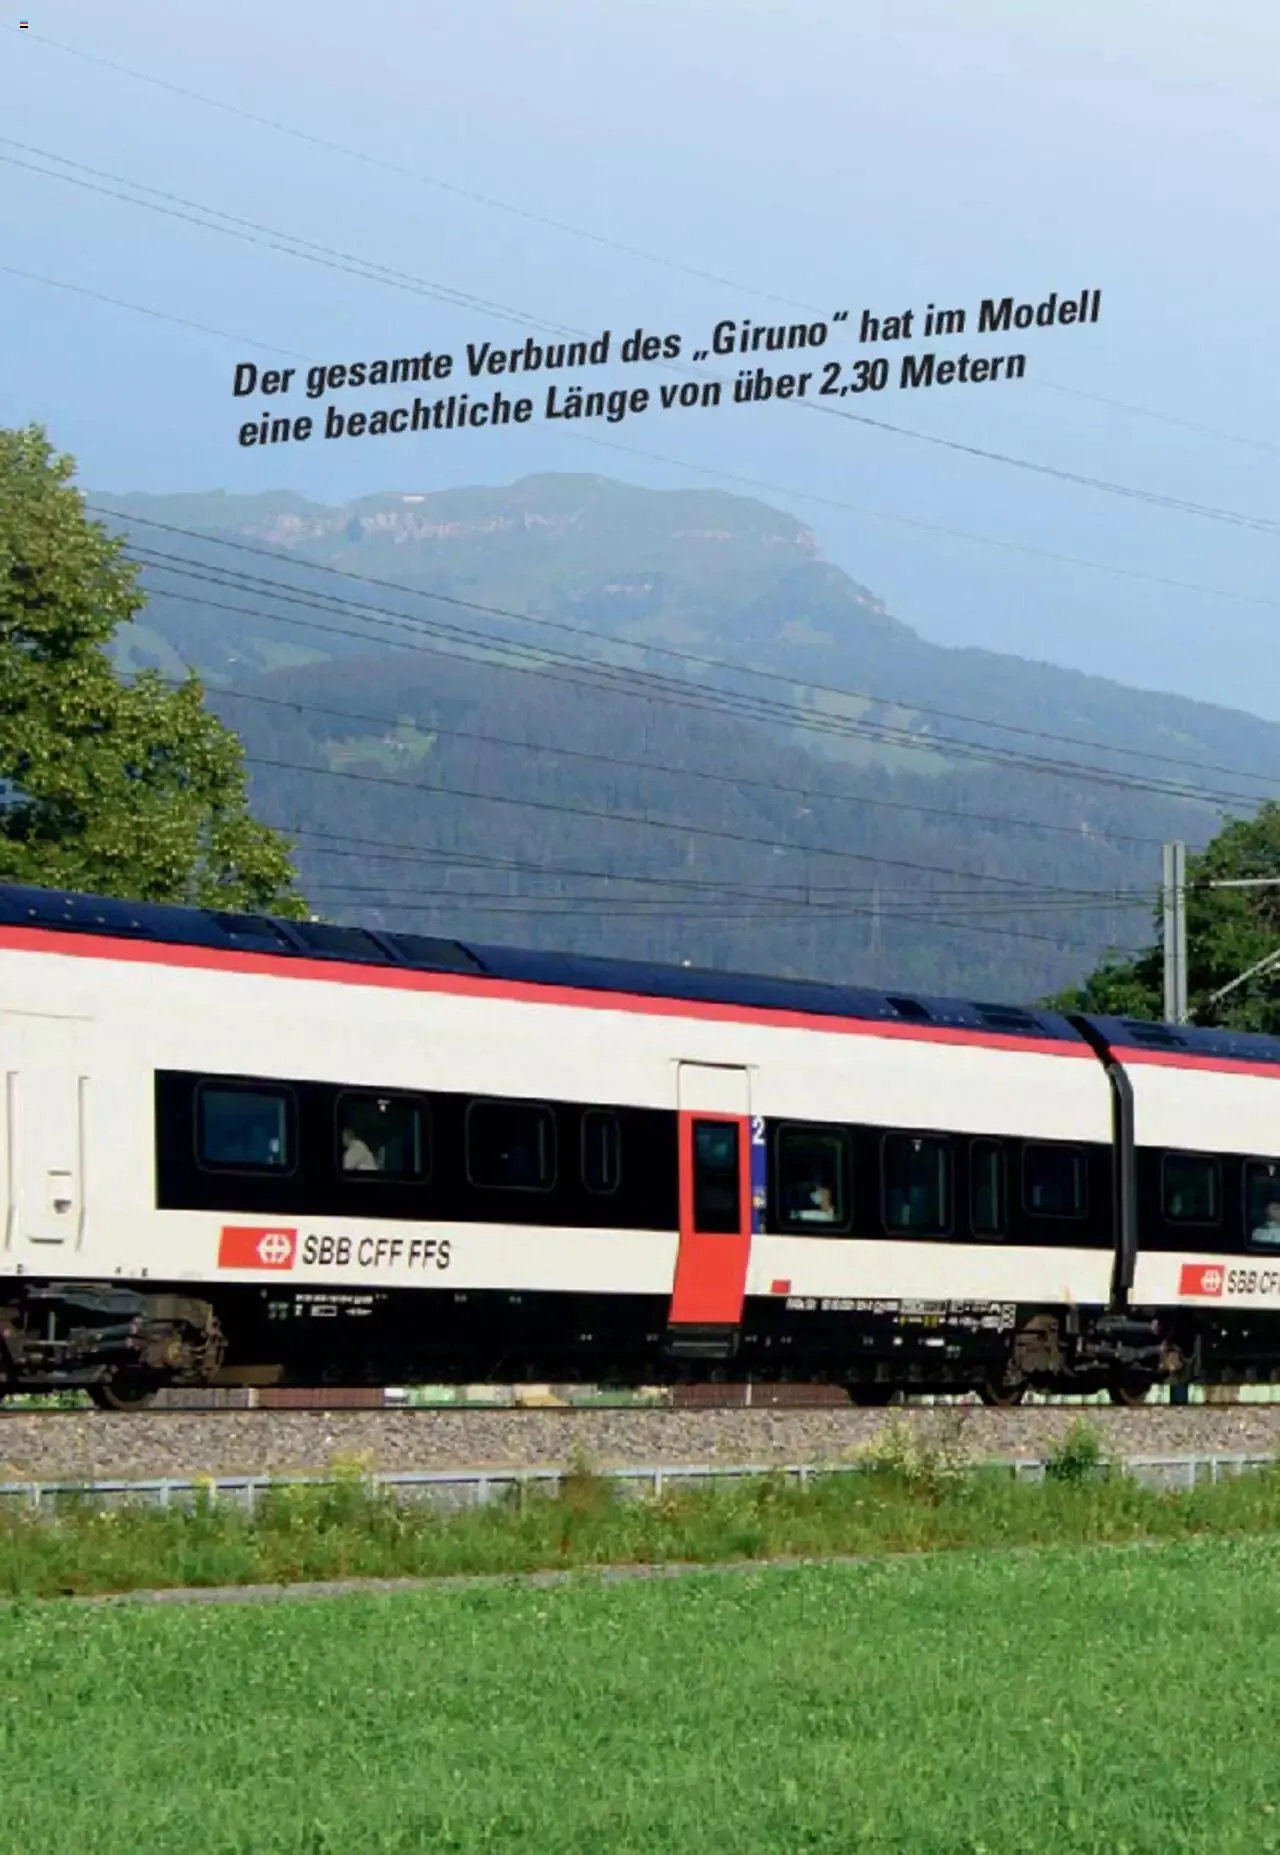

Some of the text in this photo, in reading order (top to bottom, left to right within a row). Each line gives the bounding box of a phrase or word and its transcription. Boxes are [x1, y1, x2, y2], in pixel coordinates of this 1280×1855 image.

[751, 1116, 765, 1145] 2
[302, 1234, 451, 1270] SBB CFF FFS
[1227, 1269, 1280, 1295] SBB CF
